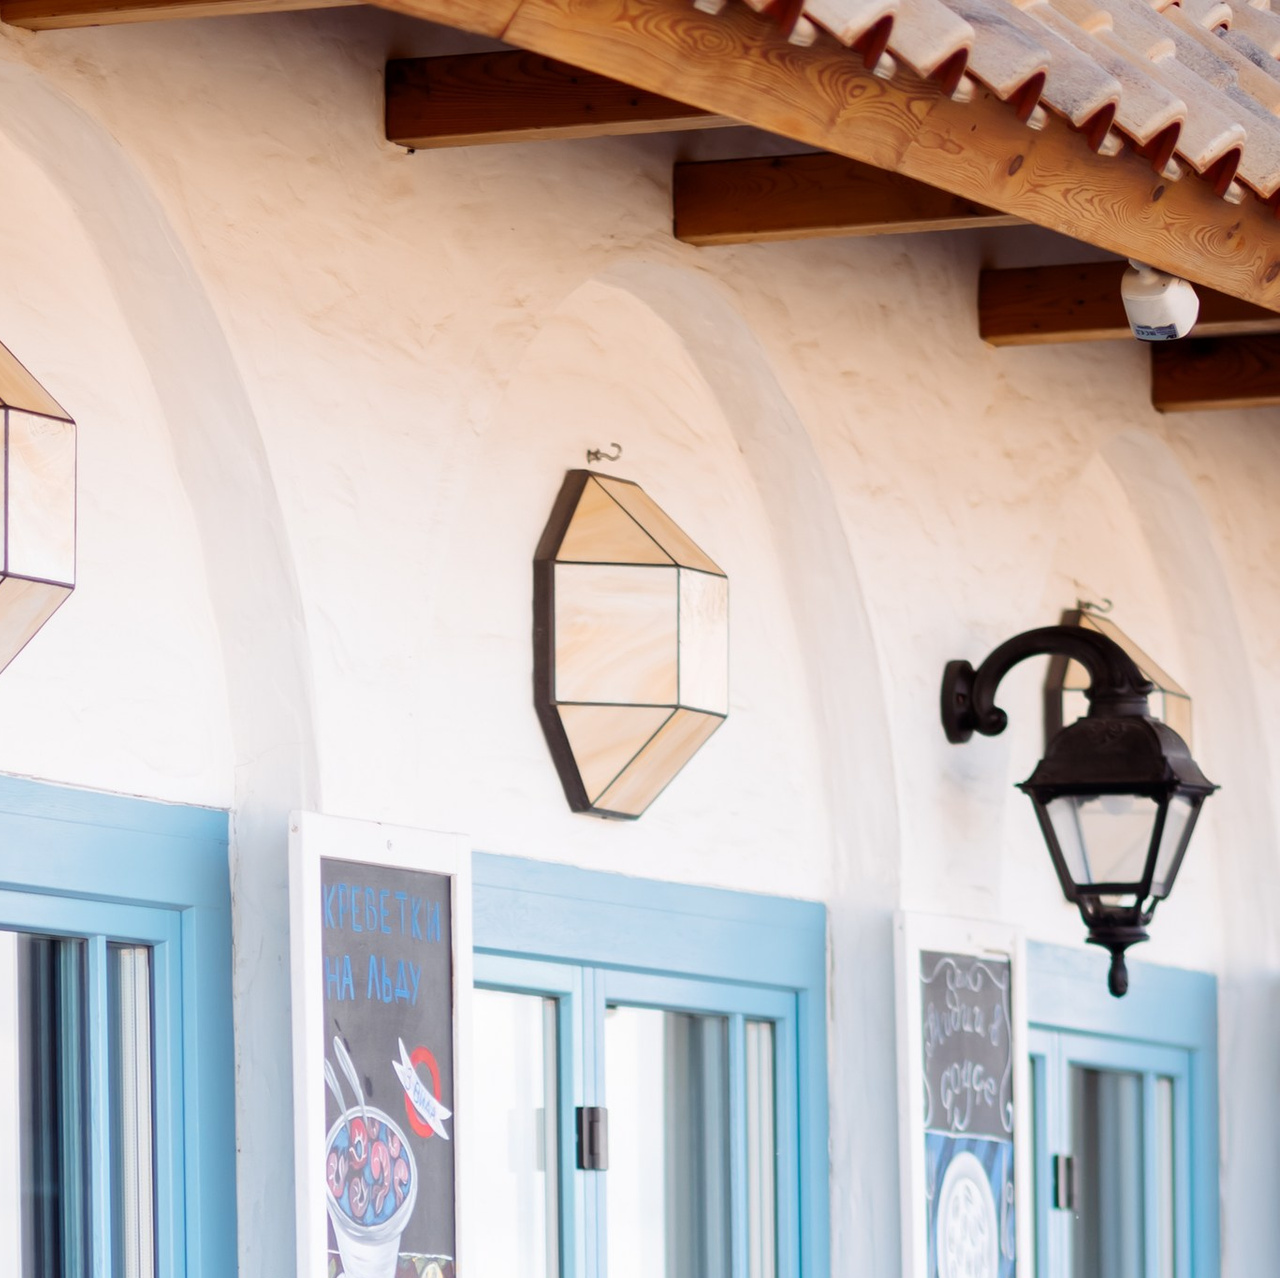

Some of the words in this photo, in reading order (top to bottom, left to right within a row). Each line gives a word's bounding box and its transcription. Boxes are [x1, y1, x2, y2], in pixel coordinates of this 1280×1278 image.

[322, 882, 441, 944] КРЕВЕТКИ
[324, 954, 355, 1001] НА
[366, 954, 422, 1006] ЛЬДУ
